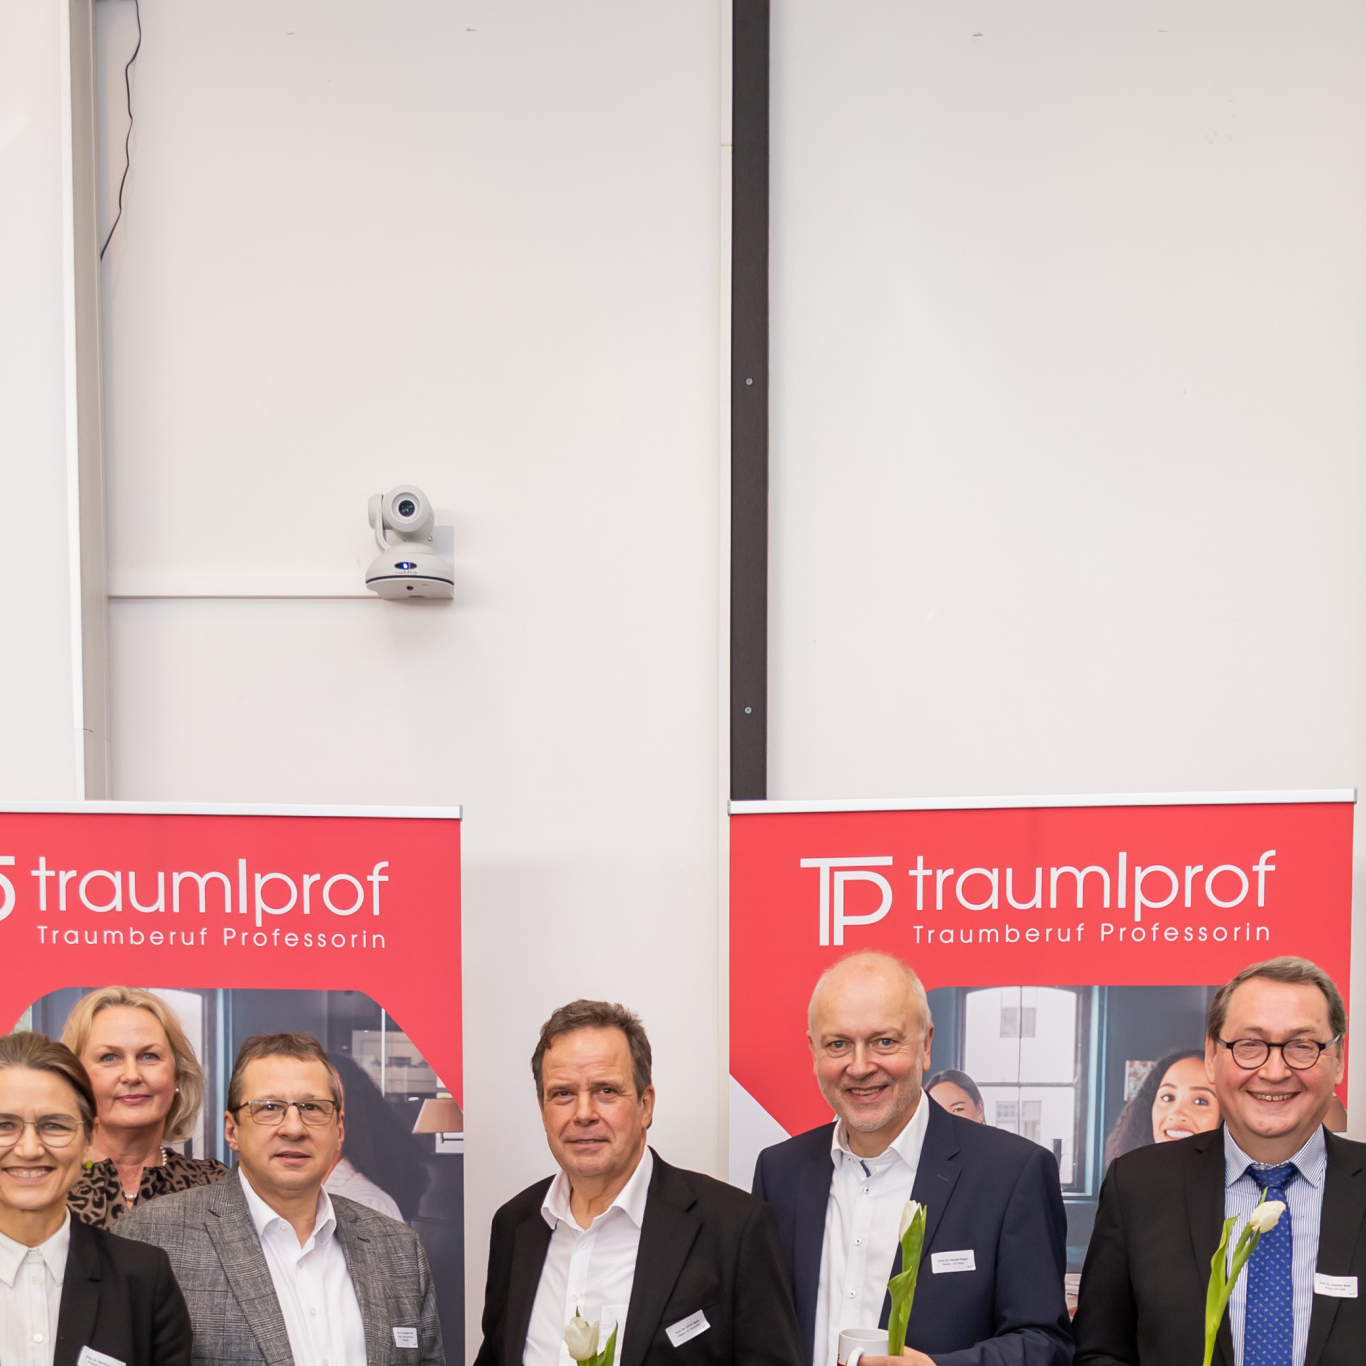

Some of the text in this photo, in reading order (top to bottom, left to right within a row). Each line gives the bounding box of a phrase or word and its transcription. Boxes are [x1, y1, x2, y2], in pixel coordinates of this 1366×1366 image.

[37, 925, 386, 949] Traumberuf Professorin
[913, 922, 1270, 944] Traumberuf Professorin
